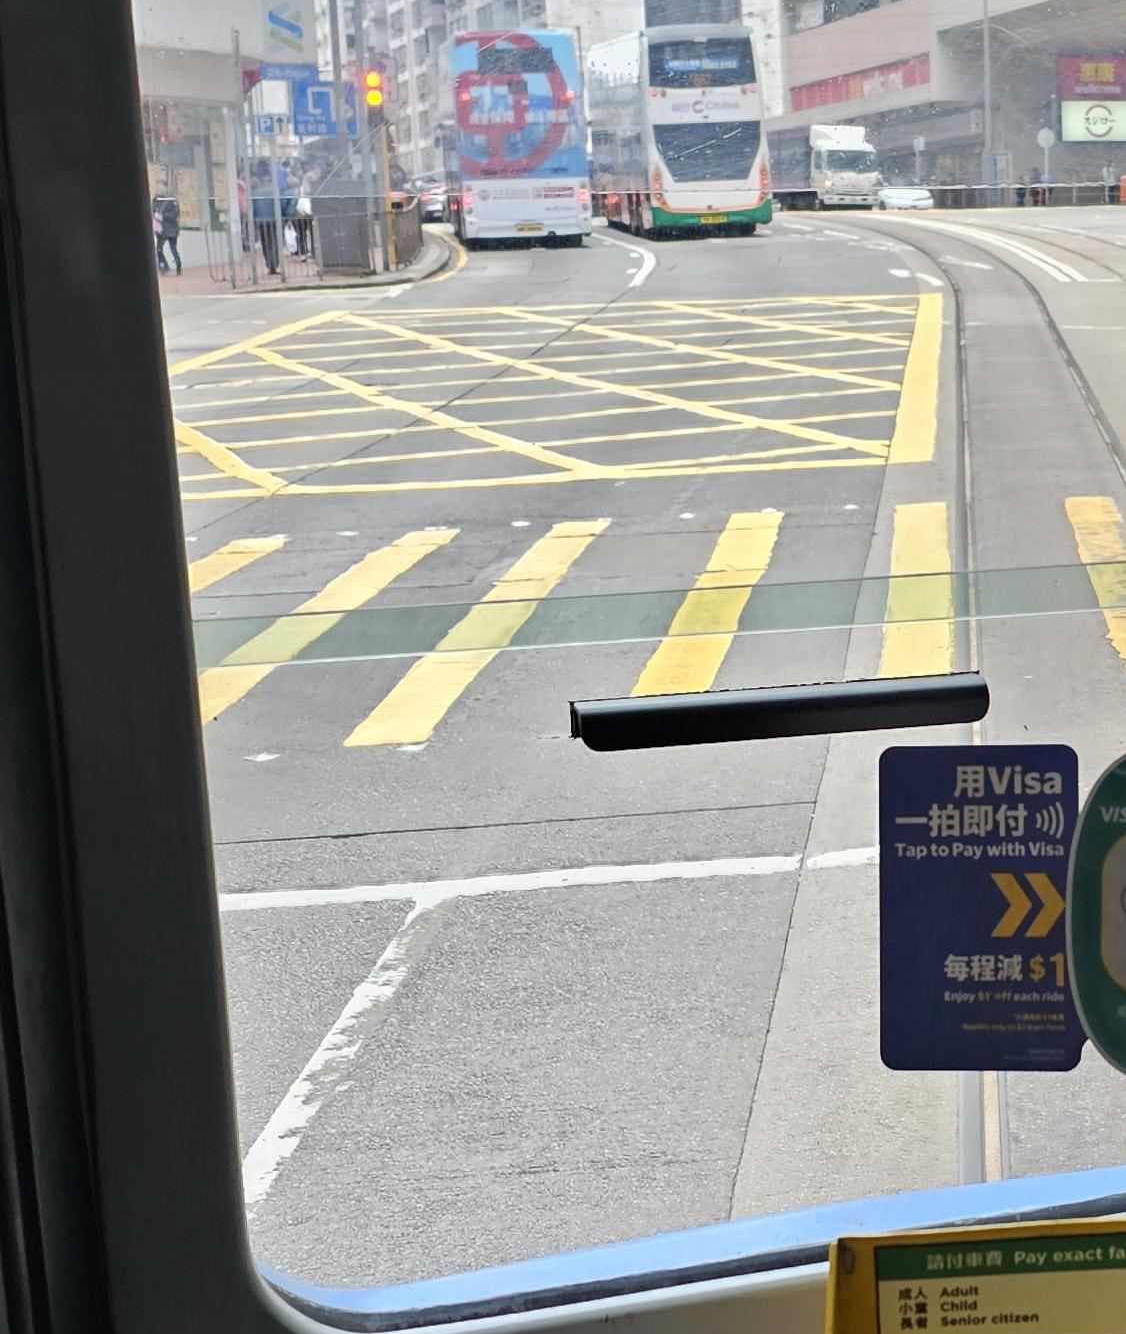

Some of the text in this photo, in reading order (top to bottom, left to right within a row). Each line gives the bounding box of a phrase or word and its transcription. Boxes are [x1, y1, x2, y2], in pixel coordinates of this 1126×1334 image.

[953, 765, 1064, 799] 用Visa
[895, 803, 1029, 838] 一拍即付
[895, 841, 1065, 858] Tap to Pay with Visa
[944, 952, 1065, 987] 每程減 $1
[944, 991, 976, 1003] Enjoy
[994, 990, 1013, 1002] off
[1013, 991, 1039, 1003] each
[1041, 990, 1065, 1003] ride
[927, 1252, 1004, 1272] 請付車費
[1014, 1251, 1047, 1267] Pay
[1053, 1249, 1103, 1264] exact
[898, 1286, 928, 1302] 成人
[940, 1285, 979, 1298] Adult
[899, 1300, 928, 1316] 小童
[940, 1299, 978, 1312] Child
[900, 1315, 928, 1330] 長者
[940, 1314, 987, 1327] Senior
[991, 1312, 1039, 1325] citizen
